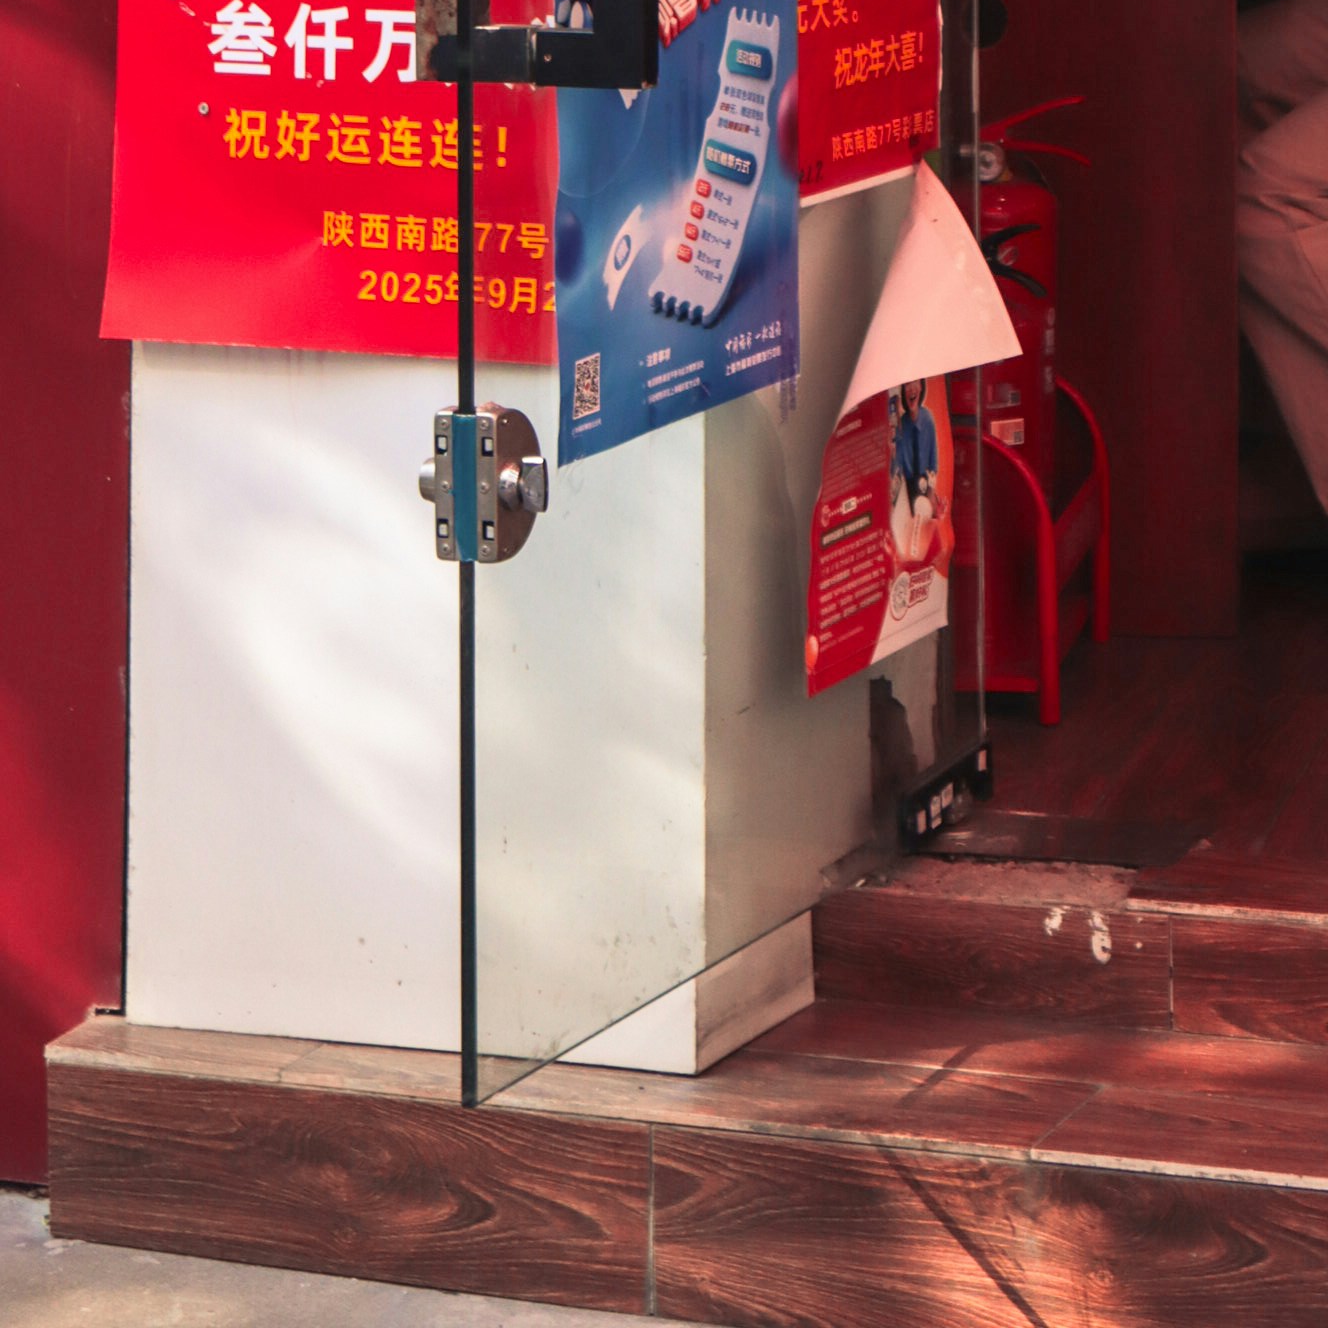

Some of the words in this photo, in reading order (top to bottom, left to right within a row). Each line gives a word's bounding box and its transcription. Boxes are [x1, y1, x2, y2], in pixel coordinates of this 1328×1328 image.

[832, 108, 936, 162] 陕西南路77号彩票店
